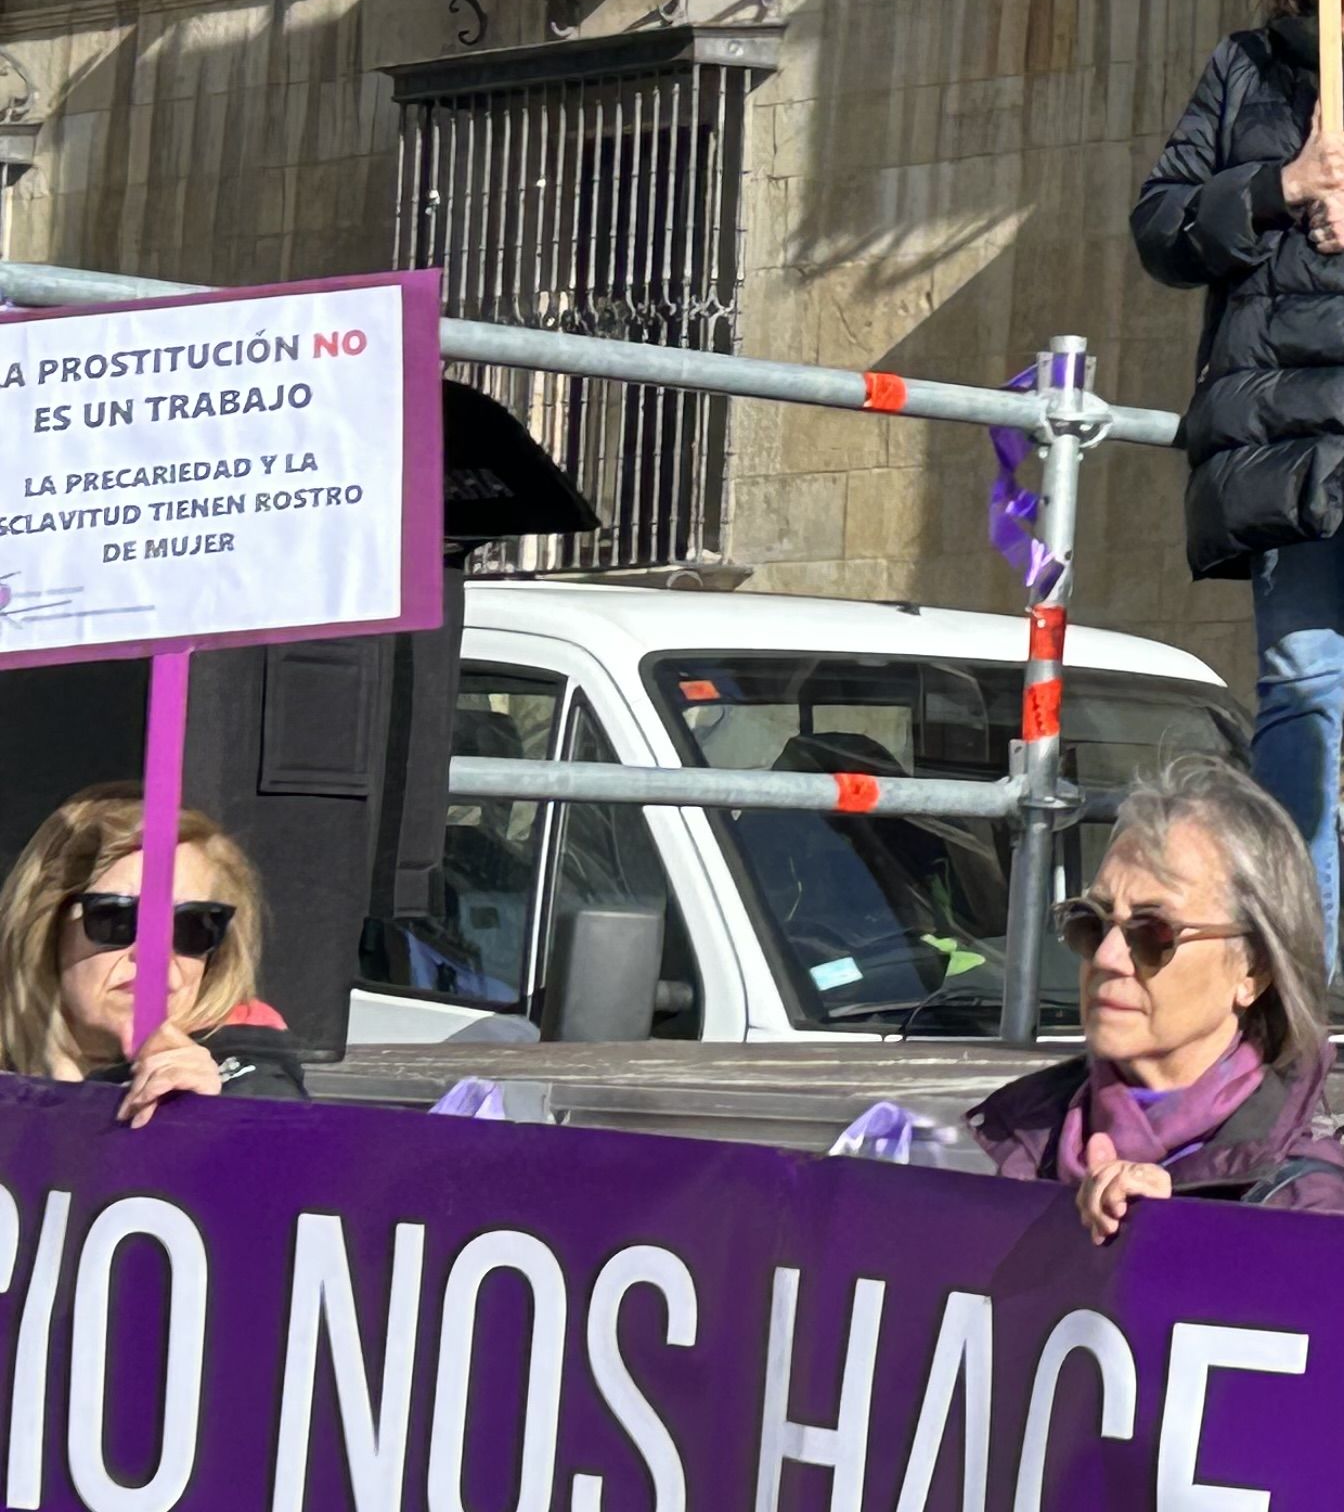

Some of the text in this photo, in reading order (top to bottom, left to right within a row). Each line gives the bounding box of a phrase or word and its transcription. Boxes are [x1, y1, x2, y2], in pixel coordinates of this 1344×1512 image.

[37, 328, 301, 385] PROSTITUCIÓN
[312, 329, 367, 359] NO
[34, 382, 313, 433] ES UN TRABAJO
[24, 452, 318, 497] LA PRECARIEDAD Y LA
[149, 494, 245, 522] TIENEN
[255, 484, 363, 512] ROSTRO
[102, 533, 235, 563] DE MUJER
[273, 1212, 698, 1512] NOS
